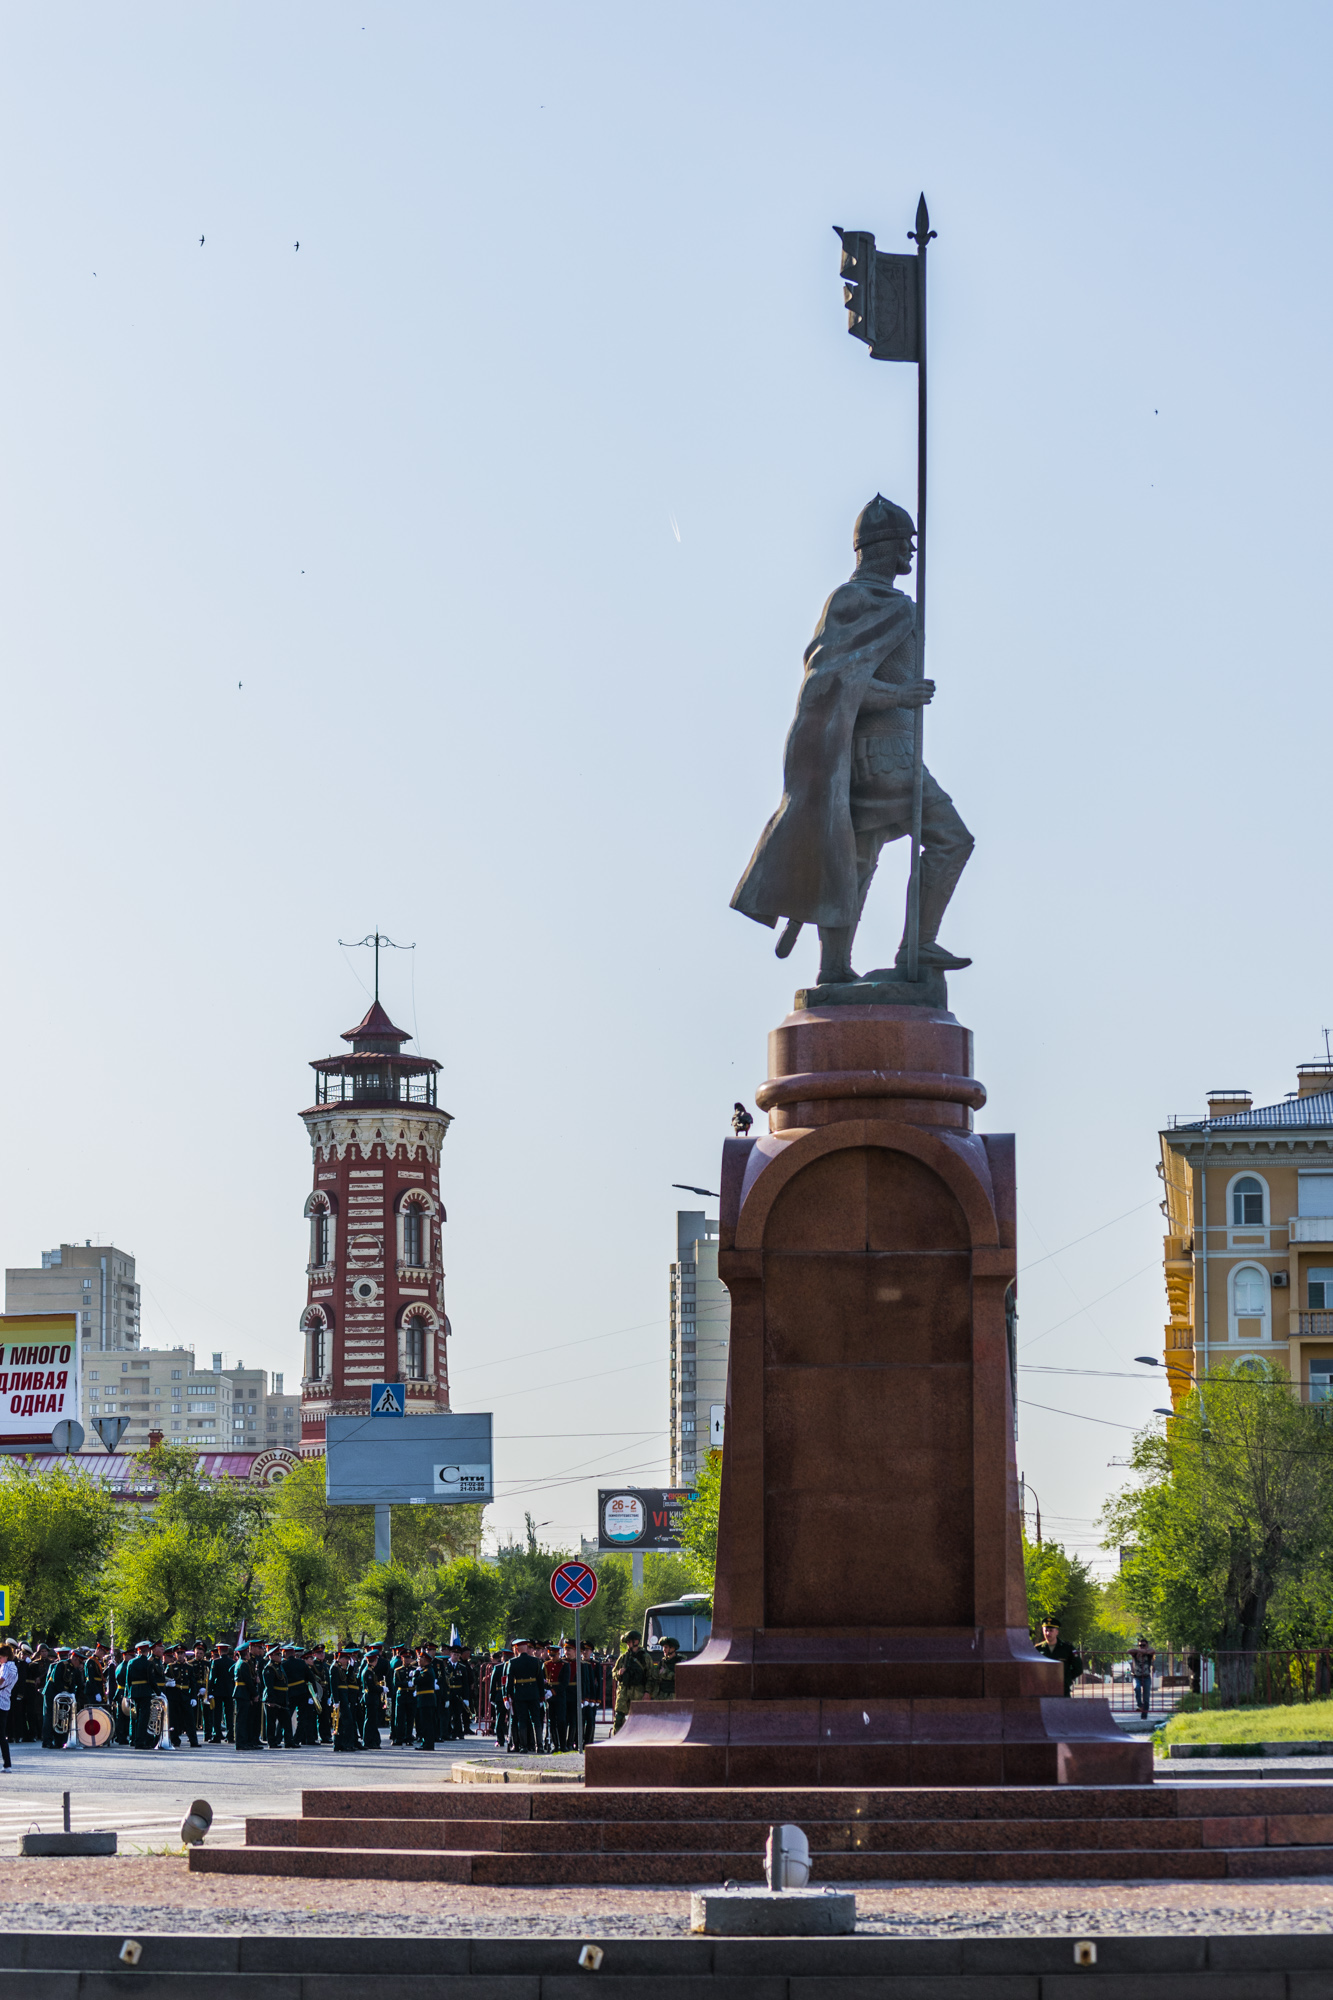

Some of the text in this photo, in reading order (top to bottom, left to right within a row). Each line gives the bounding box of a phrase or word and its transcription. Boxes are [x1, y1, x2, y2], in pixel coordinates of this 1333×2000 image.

[10, 1344, 72, 1366] МНОГО
[10, 1394, 64, 1416] ОДНА!
[612, 1500, 623, 1509] 26
[631, 1500, 636, 1509] 2
[652, 1511, 667, 1527] VI
